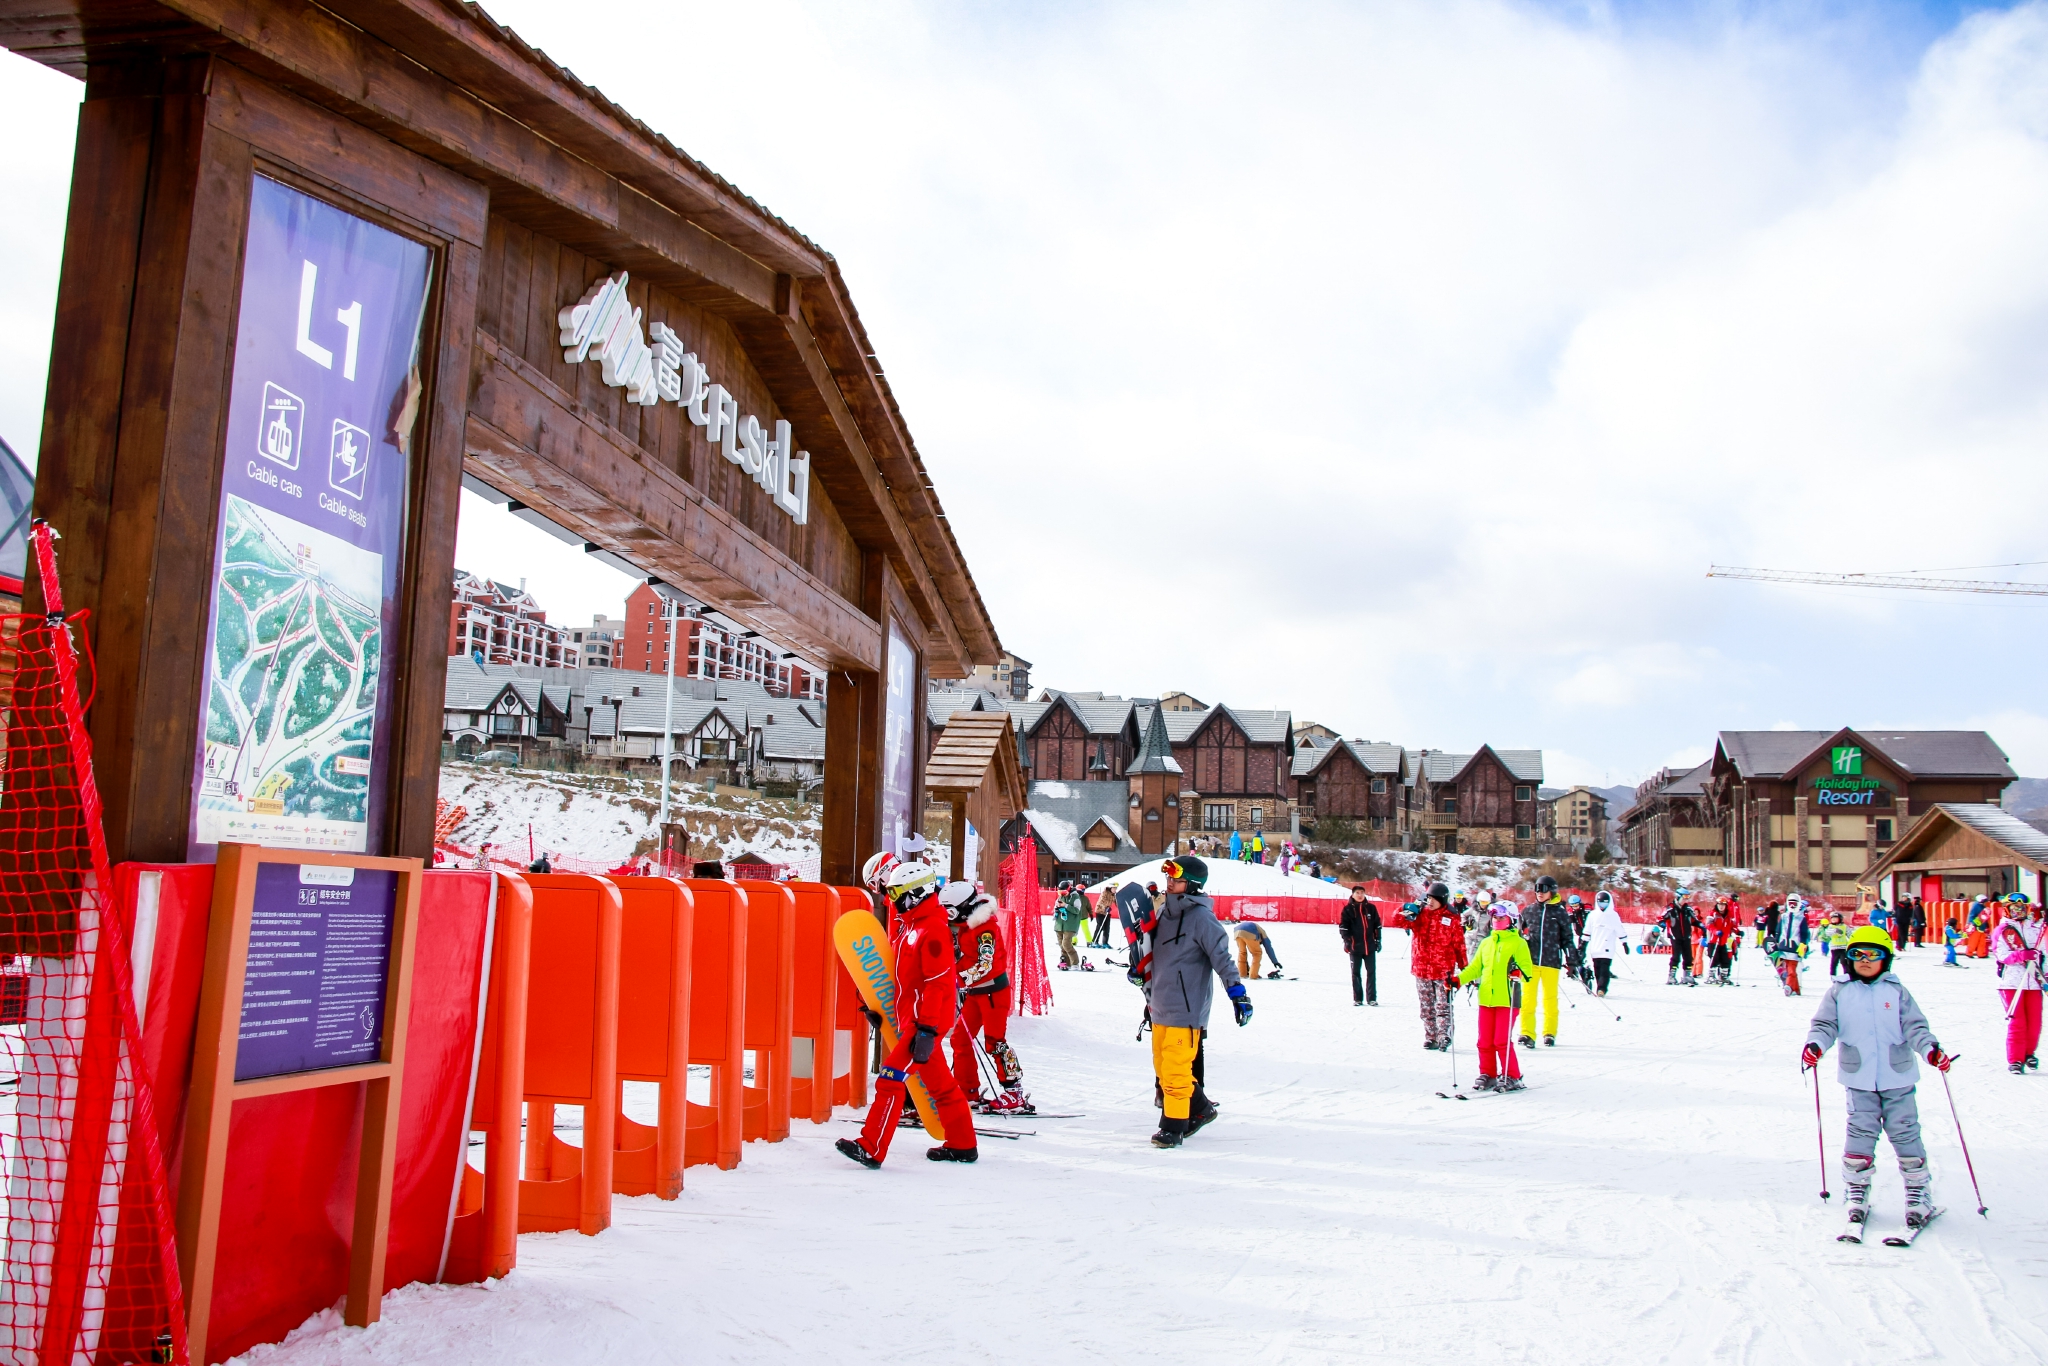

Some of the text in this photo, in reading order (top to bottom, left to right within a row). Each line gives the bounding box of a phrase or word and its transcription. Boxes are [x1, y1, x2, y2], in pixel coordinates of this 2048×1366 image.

[296, 259, 363, 382] L1
[650, 322, 711, 427] 富龙
[247, 460, 303, 499] Cable cars
[319, 492, 367, 528] Cable seats
[891, 655, 904, 699] L1
[1815, 777, 1880, 792] Holiday Inn
[1817, 789, 1875, 805] Resort
